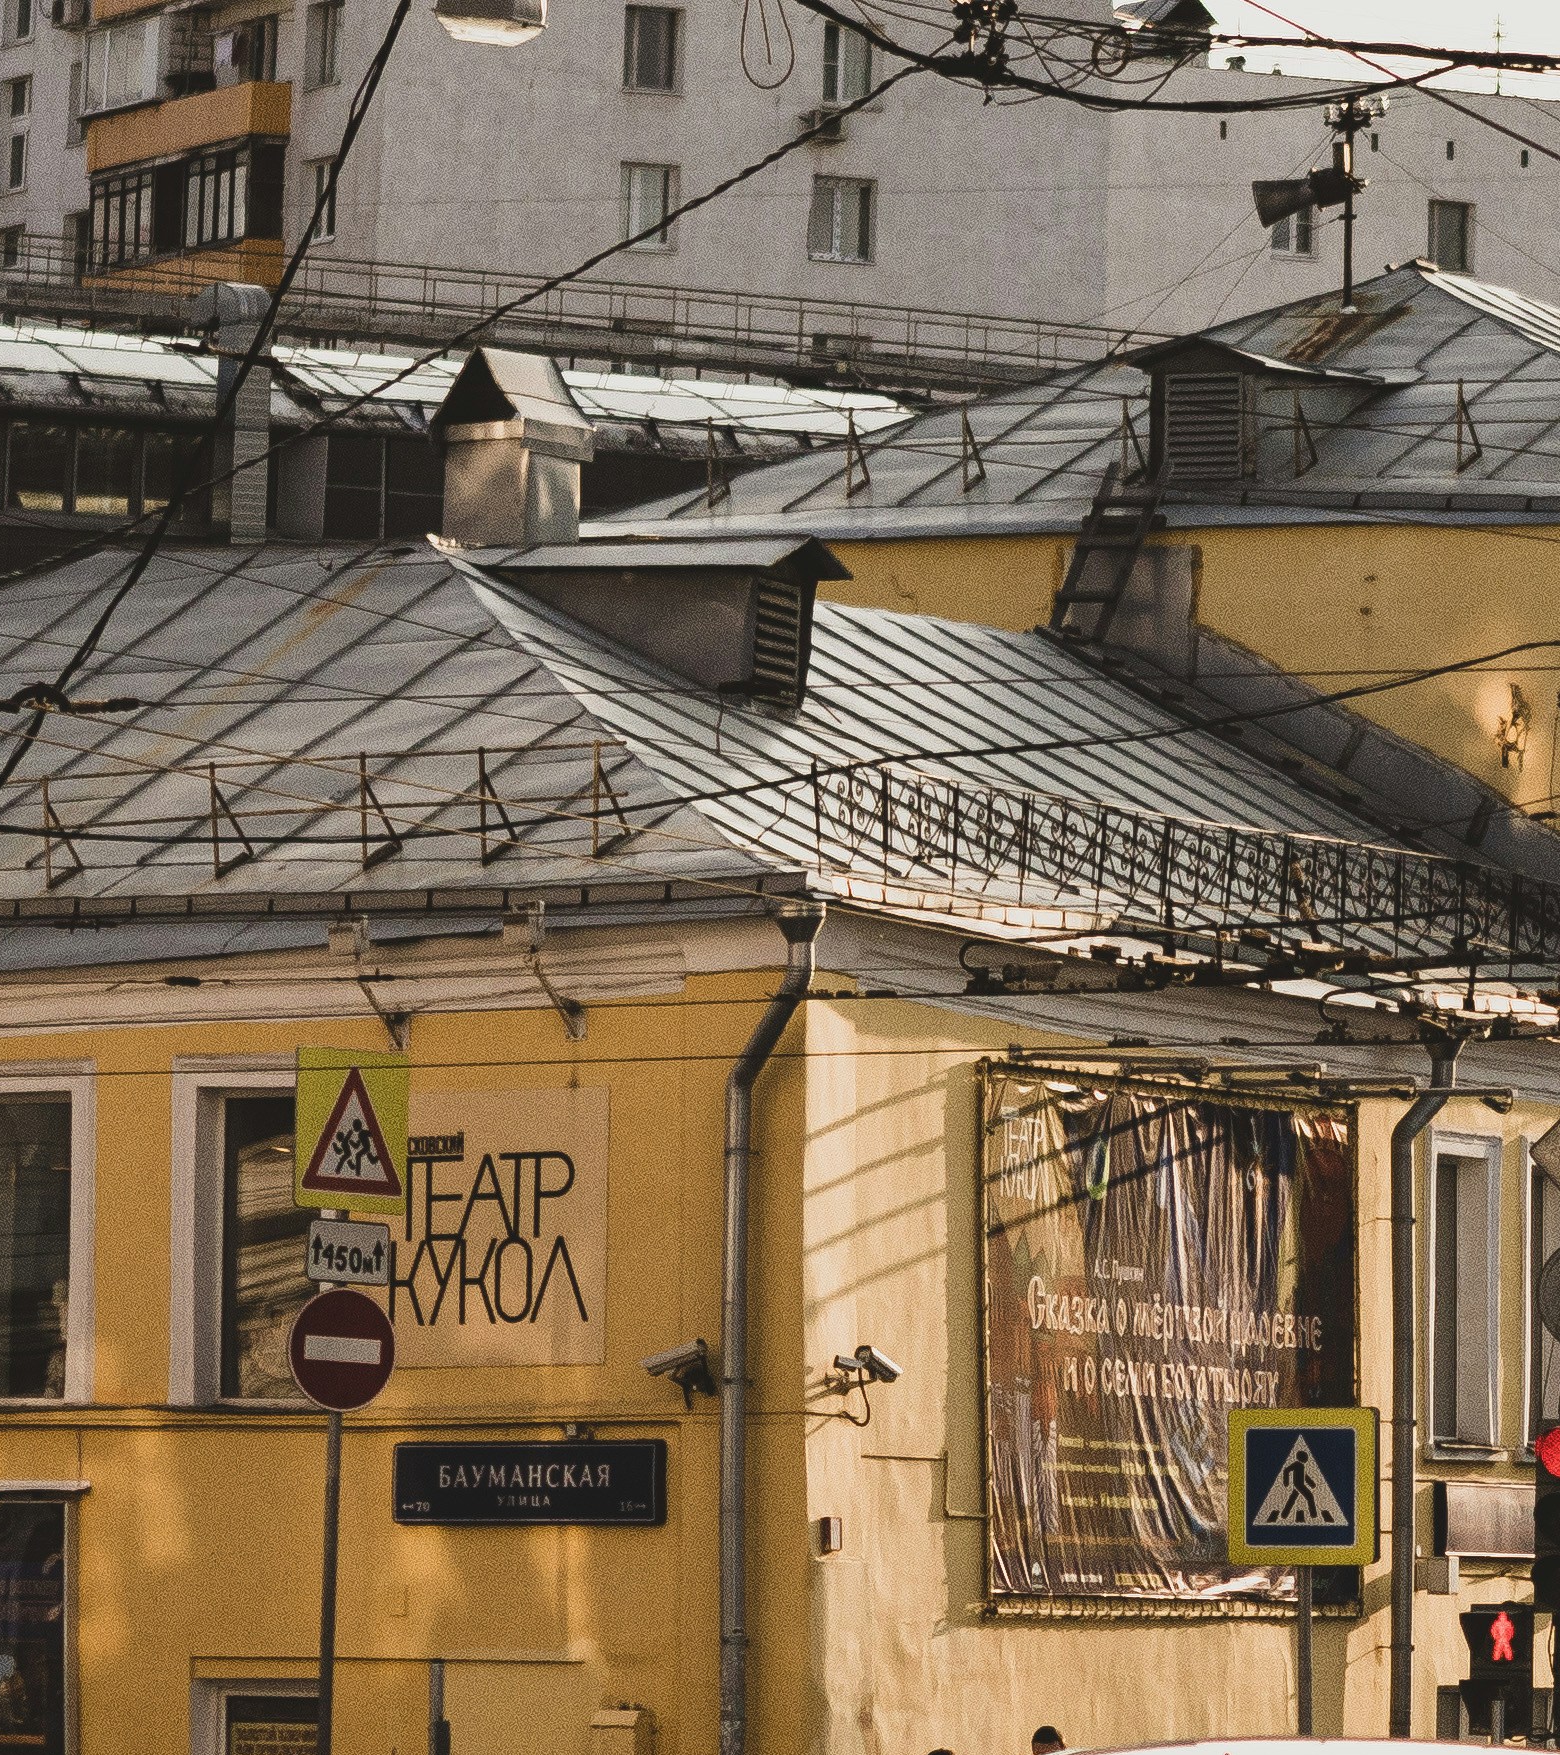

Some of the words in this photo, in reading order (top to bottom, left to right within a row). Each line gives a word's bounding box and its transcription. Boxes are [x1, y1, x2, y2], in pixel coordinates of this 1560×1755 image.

[407, 1131, 465, 1157] СКОВСКИЙ
[405, 1151, 576, 1242] ТЕАТР
[388, 1234, 589, 1326] КУКОЛ
[438, 1463, 611, 1489] БАУМАНСКАЯ
[497, 1495, 552, 1508] УЛИЦА
